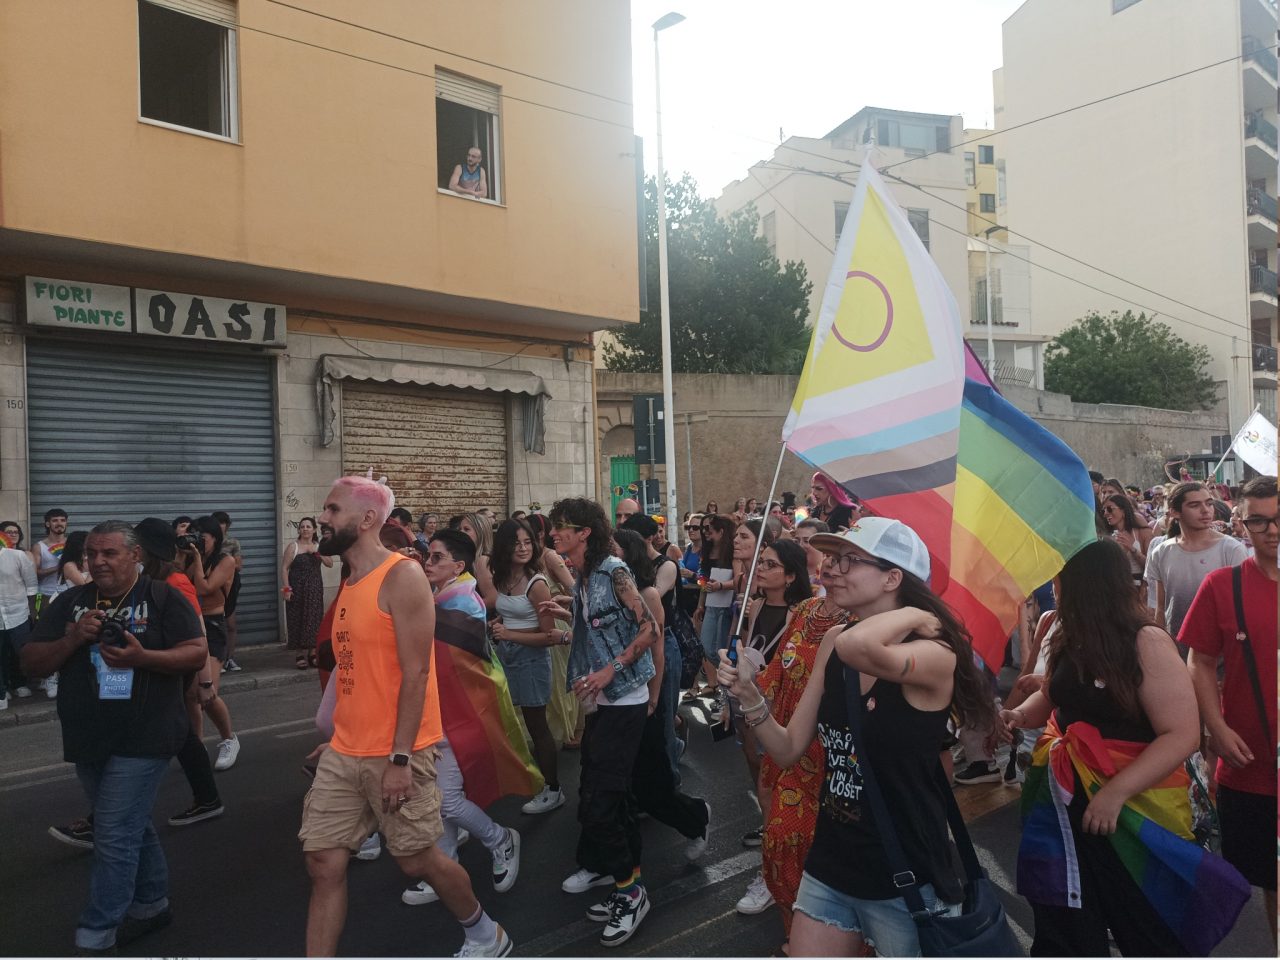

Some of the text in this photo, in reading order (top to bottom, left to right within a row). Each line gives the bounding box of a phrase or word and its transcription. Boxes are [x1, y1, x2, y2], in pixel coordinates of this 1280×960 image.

[33, 282, 276, 342] FIORI OASI
[53, 305, 126, 328] PIANTE
[6, 399, 25, 410] 150
[105, 674, 127, 682] PASS
